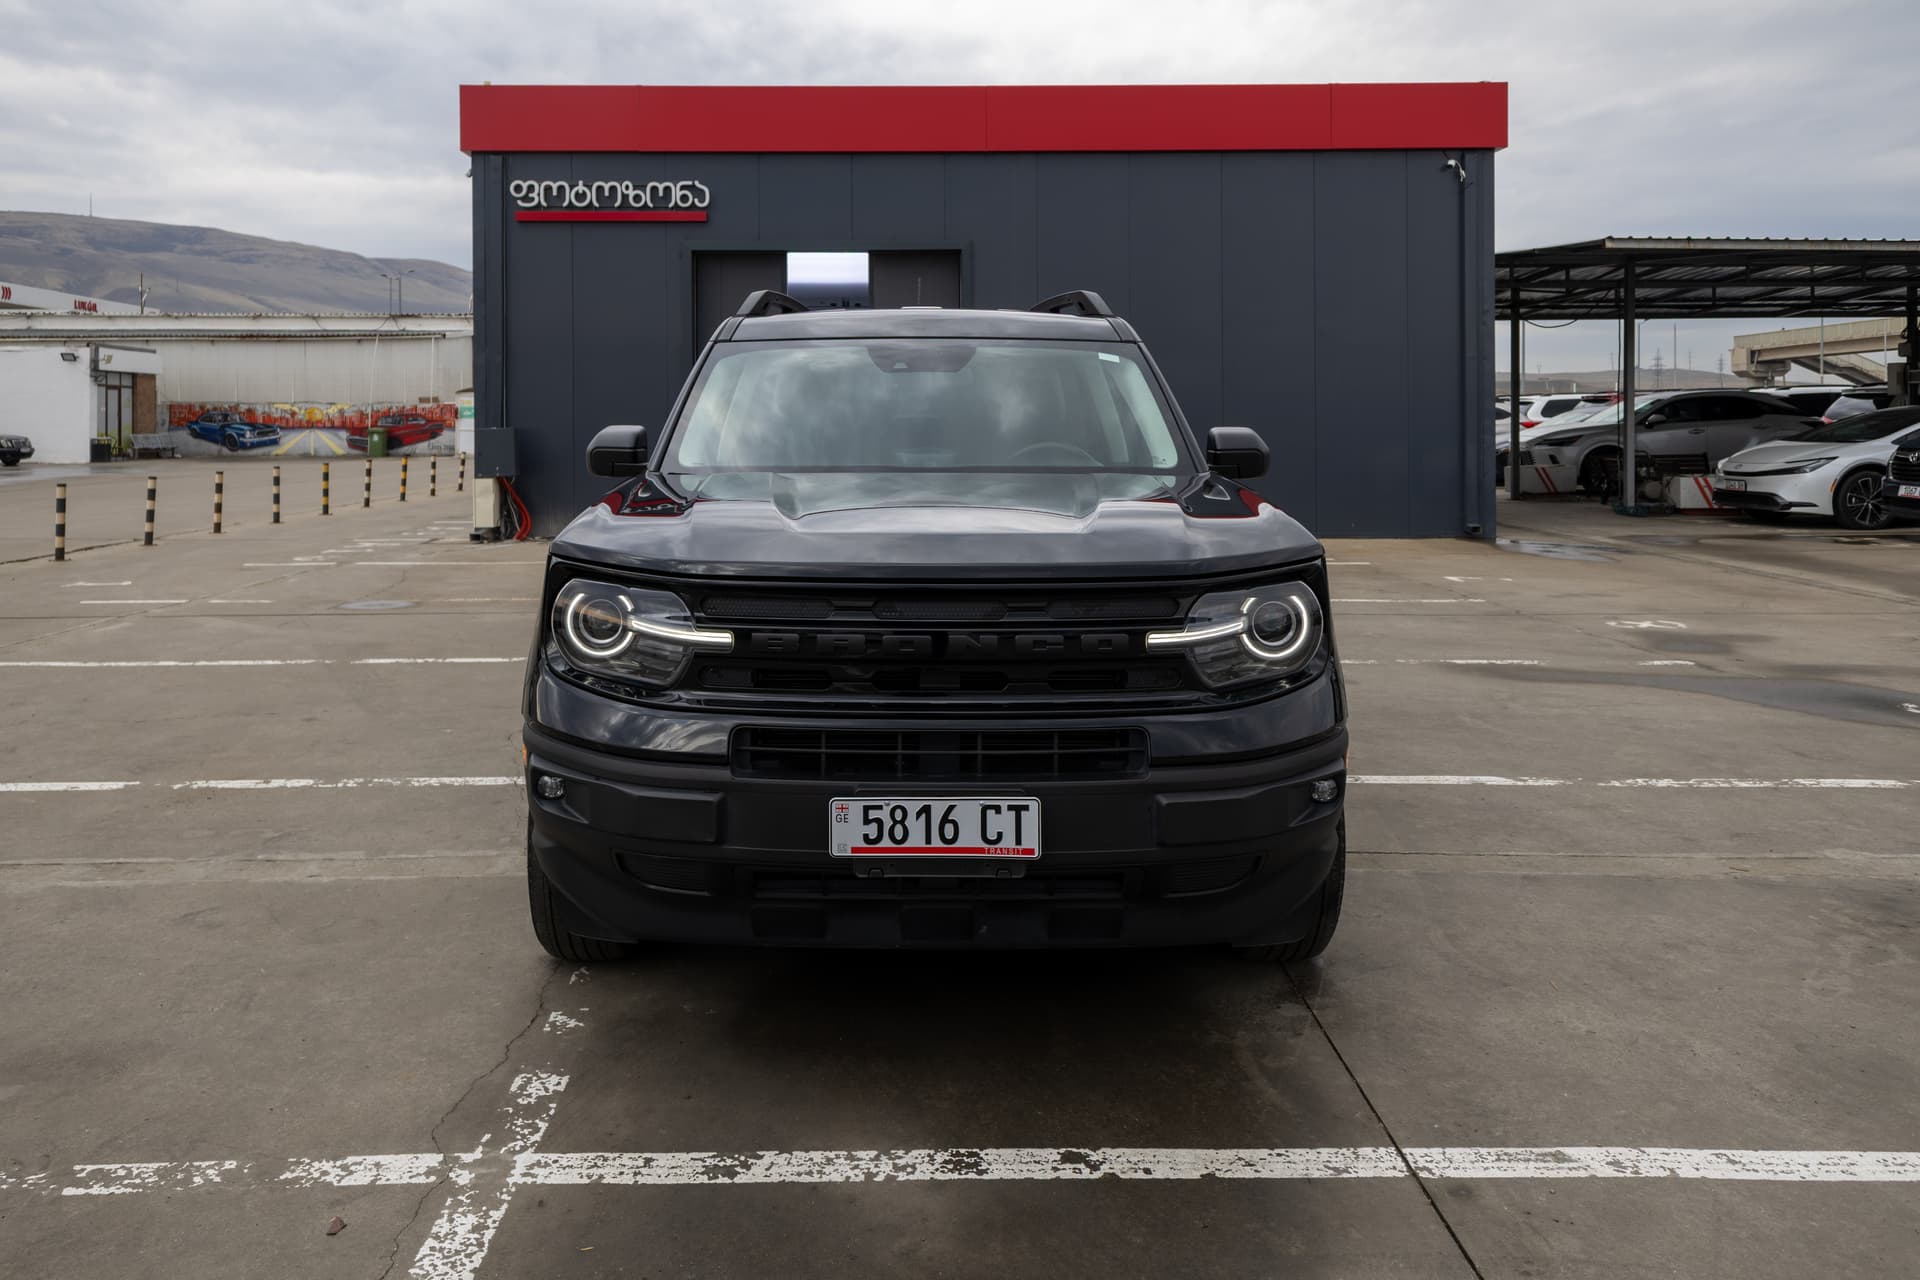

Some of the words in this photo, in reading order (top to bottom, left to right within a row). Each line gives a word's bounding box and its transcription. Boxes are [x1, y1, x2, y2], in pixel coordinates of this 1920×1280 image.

[510, 180, 710, 207] ფოტოზონა
[750, 632, 1129, 655] BRONCO
[835, 813, 849, 823] GE
[862, 804, 960, 846] 5816
[980, 804, 1030, 846] CT
[984, 847, 1024, 855] TRANSIT
